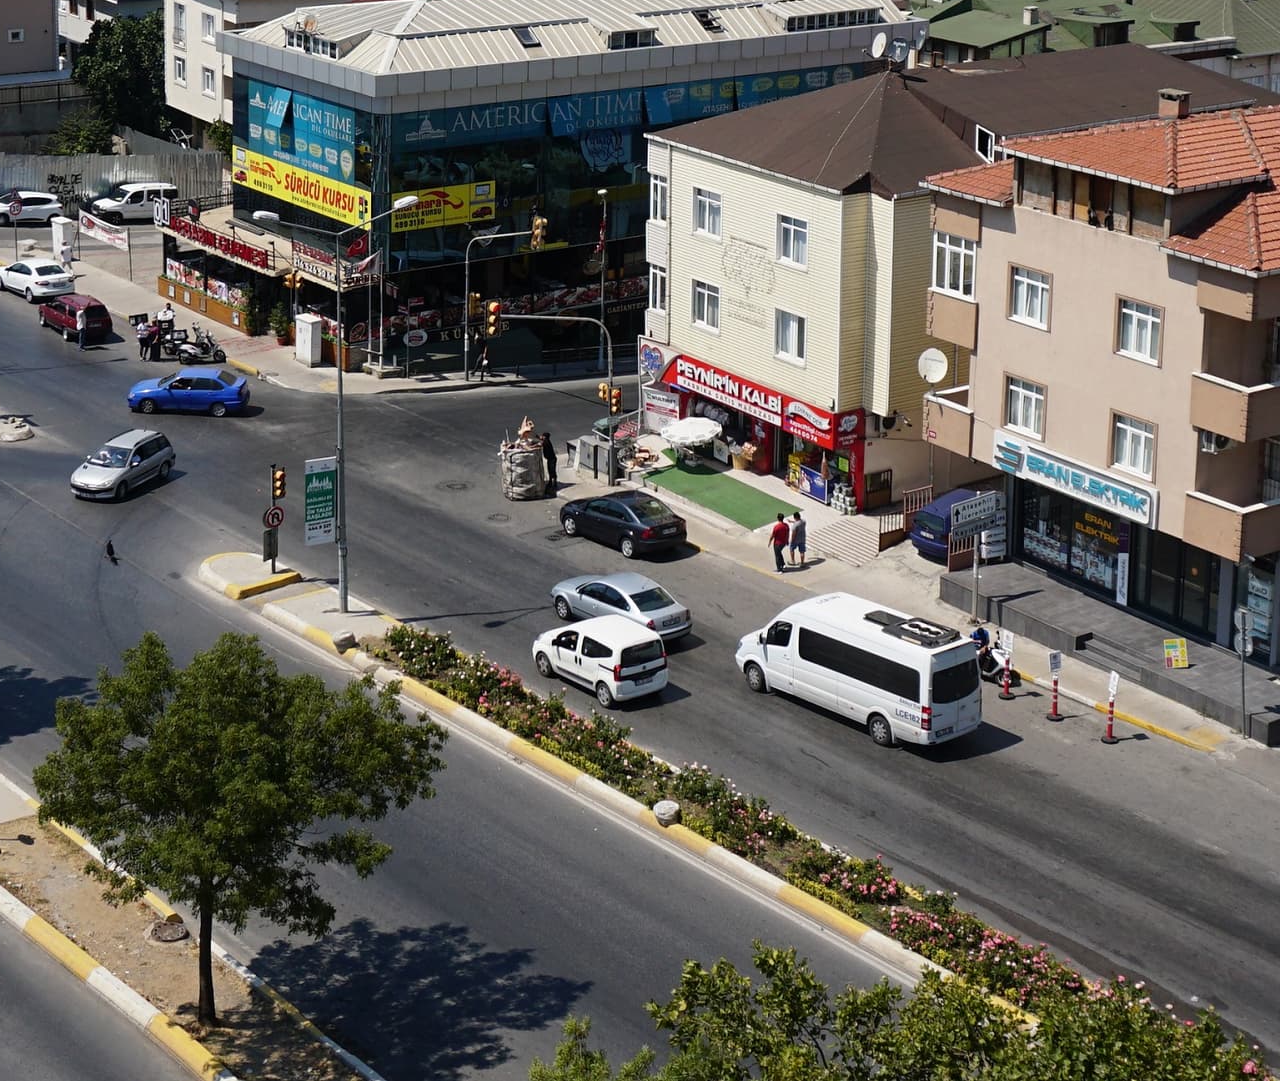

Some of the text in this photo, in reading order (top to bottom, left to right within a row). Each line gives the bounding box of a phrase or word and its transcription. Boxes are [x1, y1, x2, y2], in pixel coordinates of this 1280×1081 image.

[324, 111, 352, 134] TIME
[450, 91, 651, 134] AMERICAN TIME
[284, 171, 320, 201] SÜRÜCÜ
[321, 184, 355, 213] KURSU
[741, 384, 782, 414] KALBİ
[1075, 521, 1120, 545] ELEKTRİK
[1084, 512, 1112, 529] ERAN
